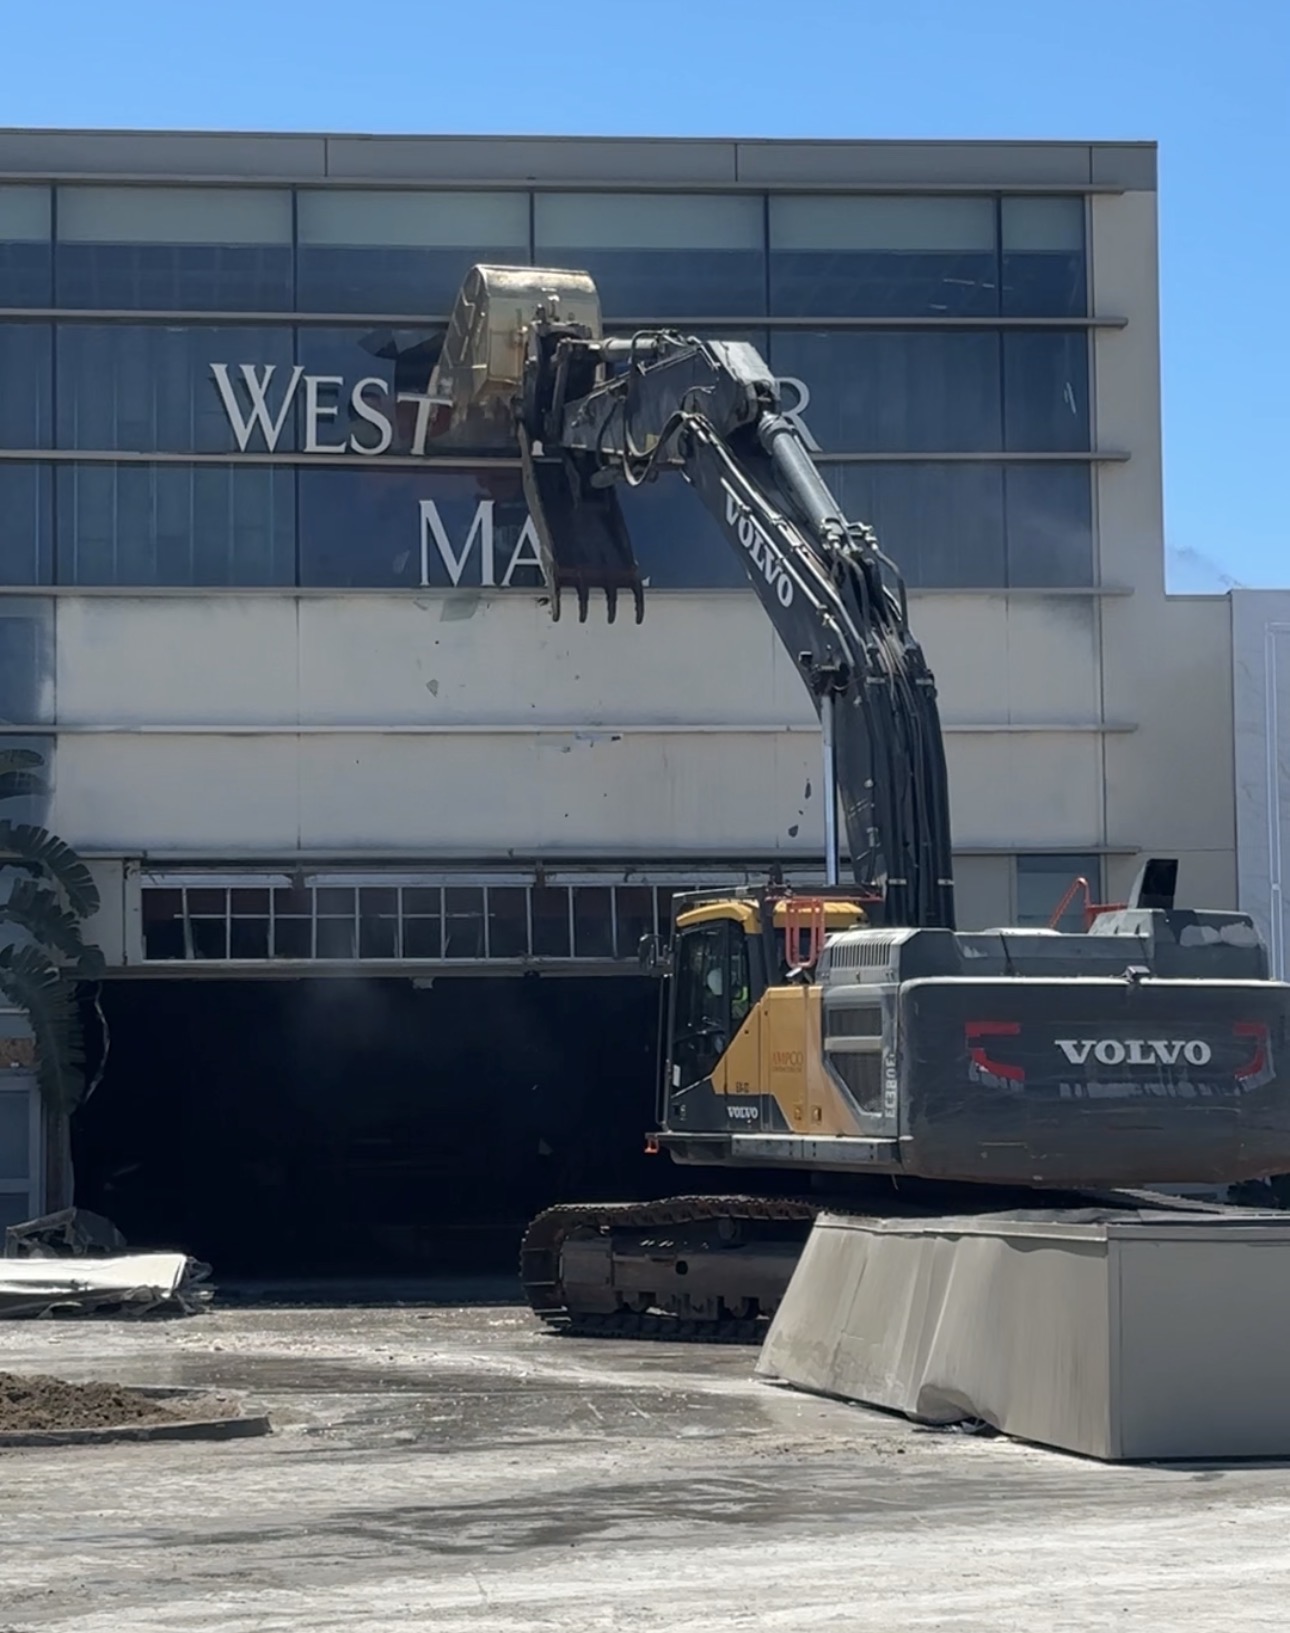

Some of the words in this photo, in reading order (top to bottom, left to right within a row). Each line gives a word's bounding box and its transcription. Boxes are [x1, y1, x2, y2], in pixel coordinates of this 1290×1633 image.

[419, 499, 650, 588] MA
[725, 494, 794, 608] VOLVO
[1055, 1040, 1212, 1066] VOLVO
[727, 1105, 759, 1119] VOLVO
